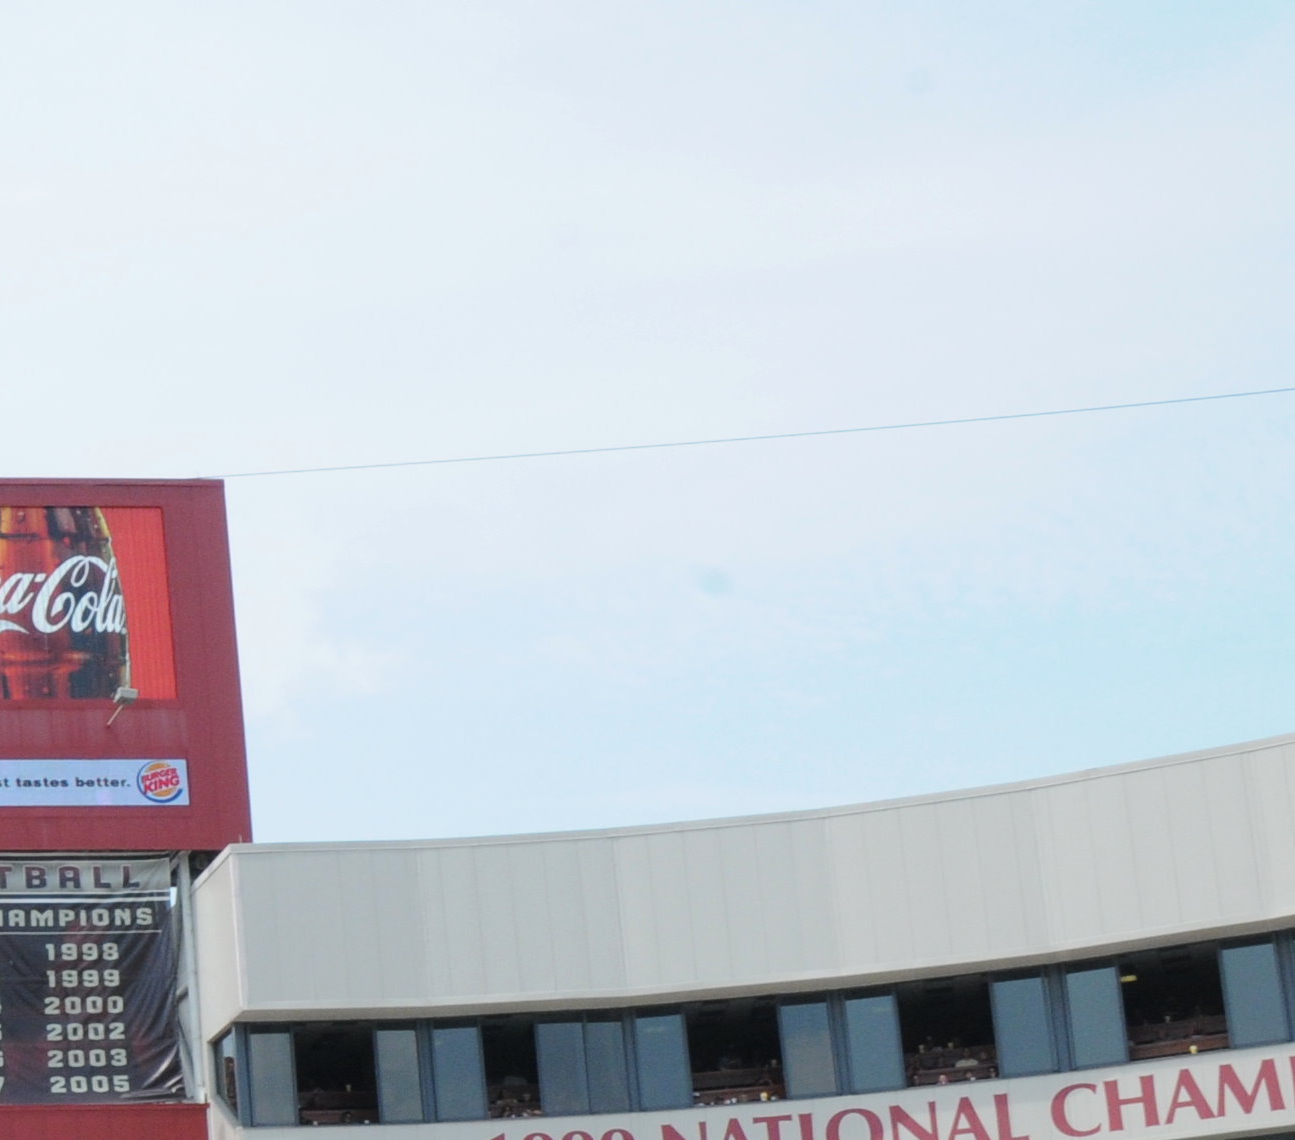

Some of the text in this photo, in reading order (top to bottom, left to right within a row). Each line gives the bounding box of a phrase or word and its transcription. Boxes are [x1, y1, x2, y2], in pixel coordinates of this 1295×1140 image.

[16, 776, 70, 789] tastes
[74, 776, 131, 789] better.
[142, 775, 181, 796] KING
[44, 942, 120, 962] 1998
[46, 968, 122, 988] 1999
[43, 995, 125, 1015] 2000
[45, 1022, 127, 1042] 2002
[47, 1048, 129, 1068] 2003
[49, 1075, 131, 1095] 2005
[1050, 1056, 1295, 1138] CHAM
